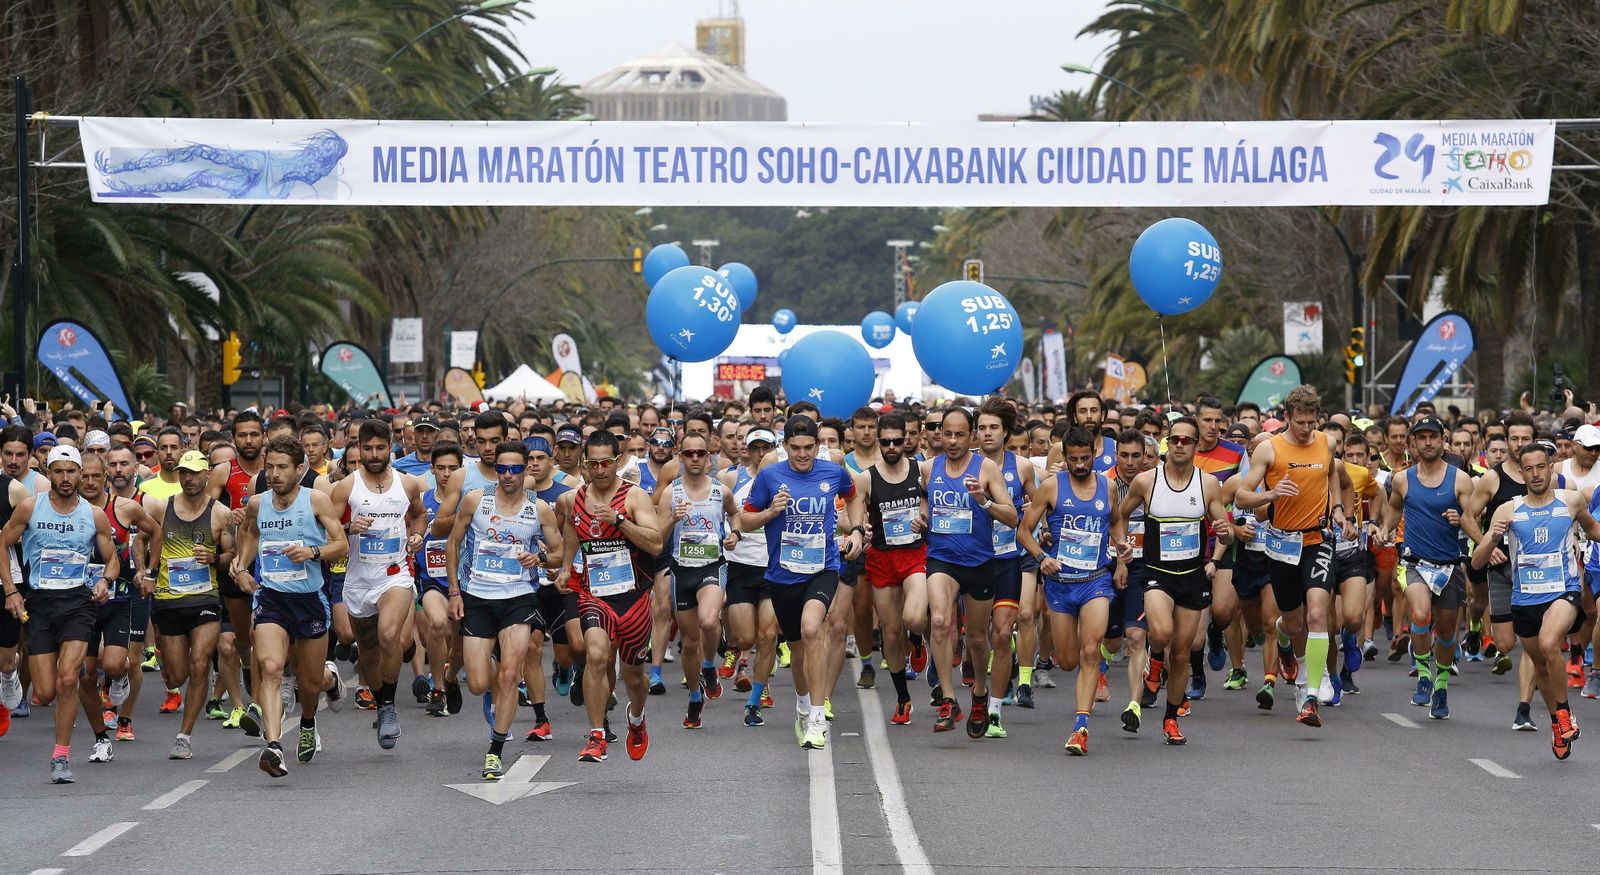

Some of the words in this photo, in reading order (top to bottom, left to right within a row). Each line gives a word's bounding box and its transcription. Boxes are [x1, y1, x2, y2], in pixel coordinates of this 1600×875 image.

[1443, 133, 1478, 146] MEDIA
[1482, 130, 1534, 146] MARATÓN
[373, 146, 468, 183] MEDIA
[478, 138, 624, 183] MARATÓN
[634, 146, 748, 184] TEATRO
[757, 146, 1028, 184] SOHO-CAIXABANK
[1037, 147, 1147, 185] CIUDAD
[1157, 147, 1193, 184] DE
[1204, 139, 1328, 184] MÁLAGA
[1374, 131, 1436, 183] 29
[1469, 177, 1534, 190] CaixaBank
[1187, 240, 1221, 264] SUB
[701, 274, 738, 312] SUB
[961, 295, 1006, 313] SUB
[966, 313, 1013, 335] 1,25'
[879, 496, 920, 511] GRANADA
[933, 489, 969, 507] RCM
[785, 497, 826, 515] RCM
[37, 520, 75, 533] nerja
[261, 517, 293, 531] nerja
[938, 519, 951, 529] 80
[1063, 513, 1102, 532] RCM
[892, 525, 905, 533] 55
[366, 542, 385, 552] 112
[1169, 539, 1182, 547] 85
[1271, 540, 1283, 550] 30
[682, 547, 705, 555] 1258
[791, 549, 805, 560] 69
[1064, 544, 1083, 556] 164
[273, 559, 279, 568] 7
[484, 559, 503, 569] 134
[49, 566, 64, 576] 57
[597, 571, 610, 582] 26
[1526, 570, 1545, 580] 102
[177, 574, 190, 583] 89
